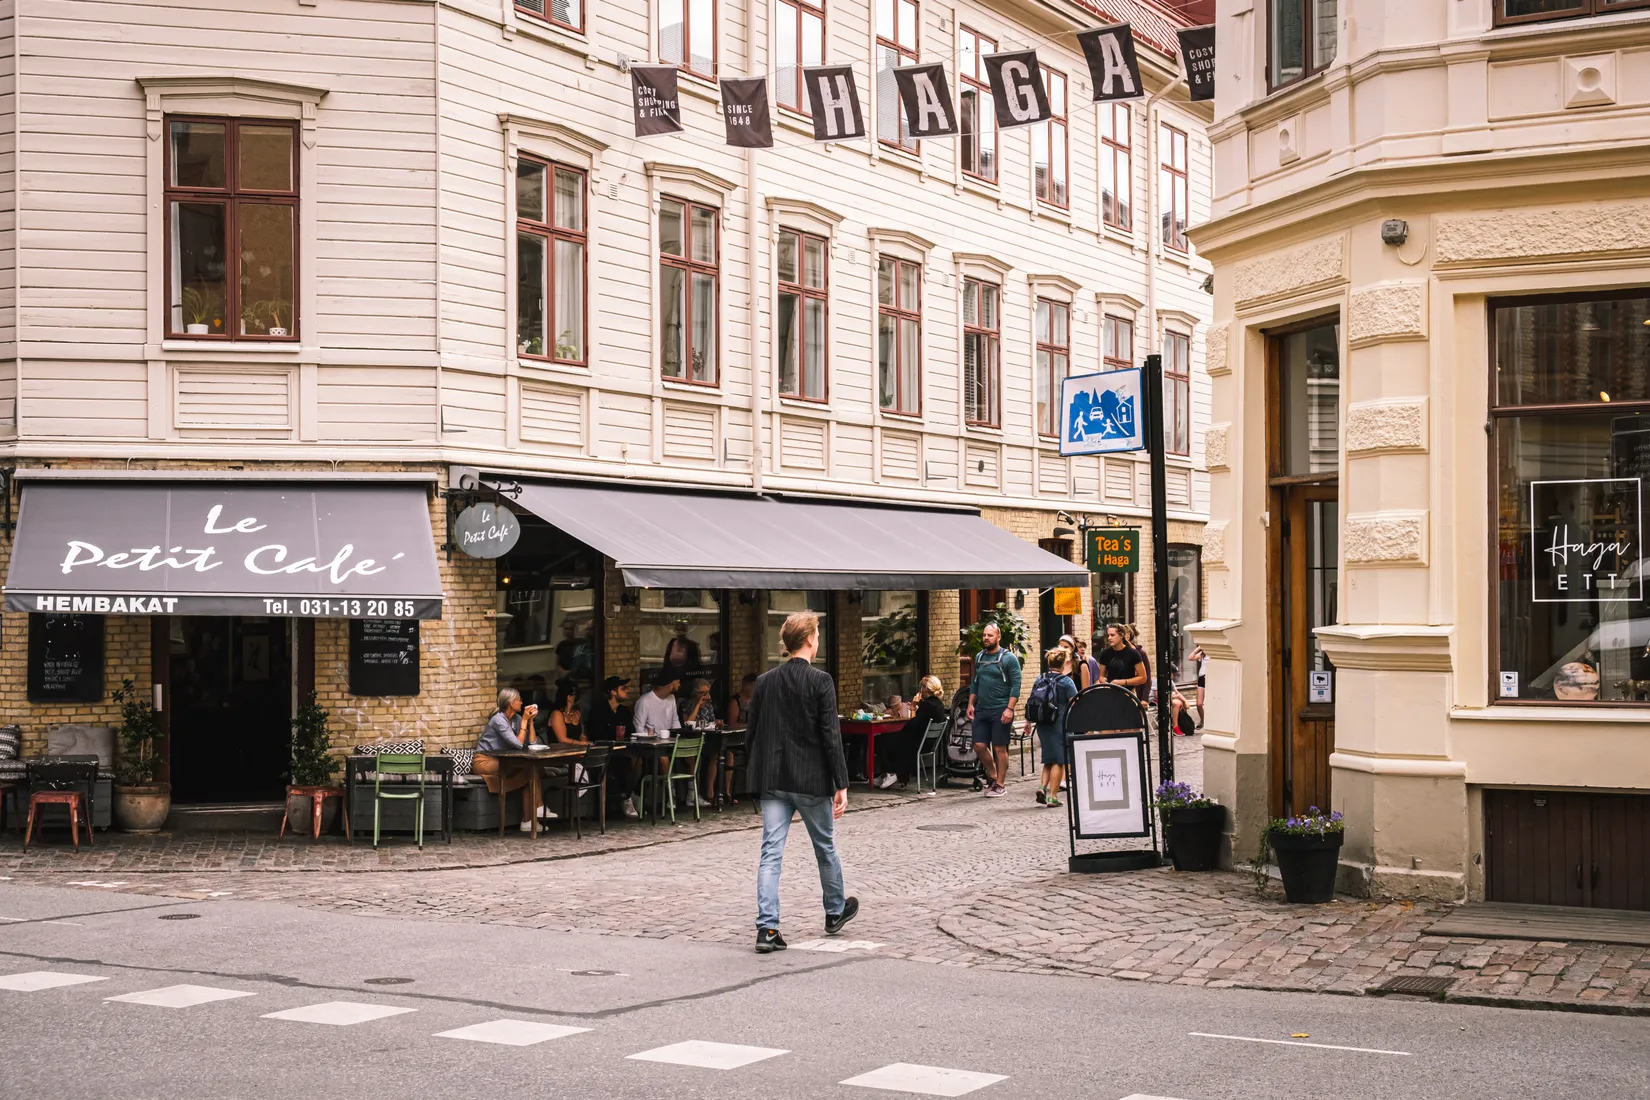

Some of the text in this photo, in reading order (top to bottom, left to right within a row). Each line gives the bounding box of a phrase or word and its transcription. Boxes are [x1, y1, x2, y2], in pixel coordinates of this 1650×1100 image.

[1189, 46, 1213, 60] COSY
[1195, 74, 1201, 84] &
[639, 109, 645, 118] &
[727, 104, 752, 114] SINCE
[729, 116, 751, 126] 1648
[204, 504, 267, 534] Le
[481, 509, 491, 523] Le
[463, 530, 486, 546] Petit
[1544, 524, 1630, 570] Haga
[60, 540, 224, 574] Petit
[1097, 554, 1130, 567] i Haga
[1558, 573, 1617, 590] ETT
[36, 596, 178, 613] HEMBAKAT
[263, 599, 415, 617] Tel. 031-13 20 85
